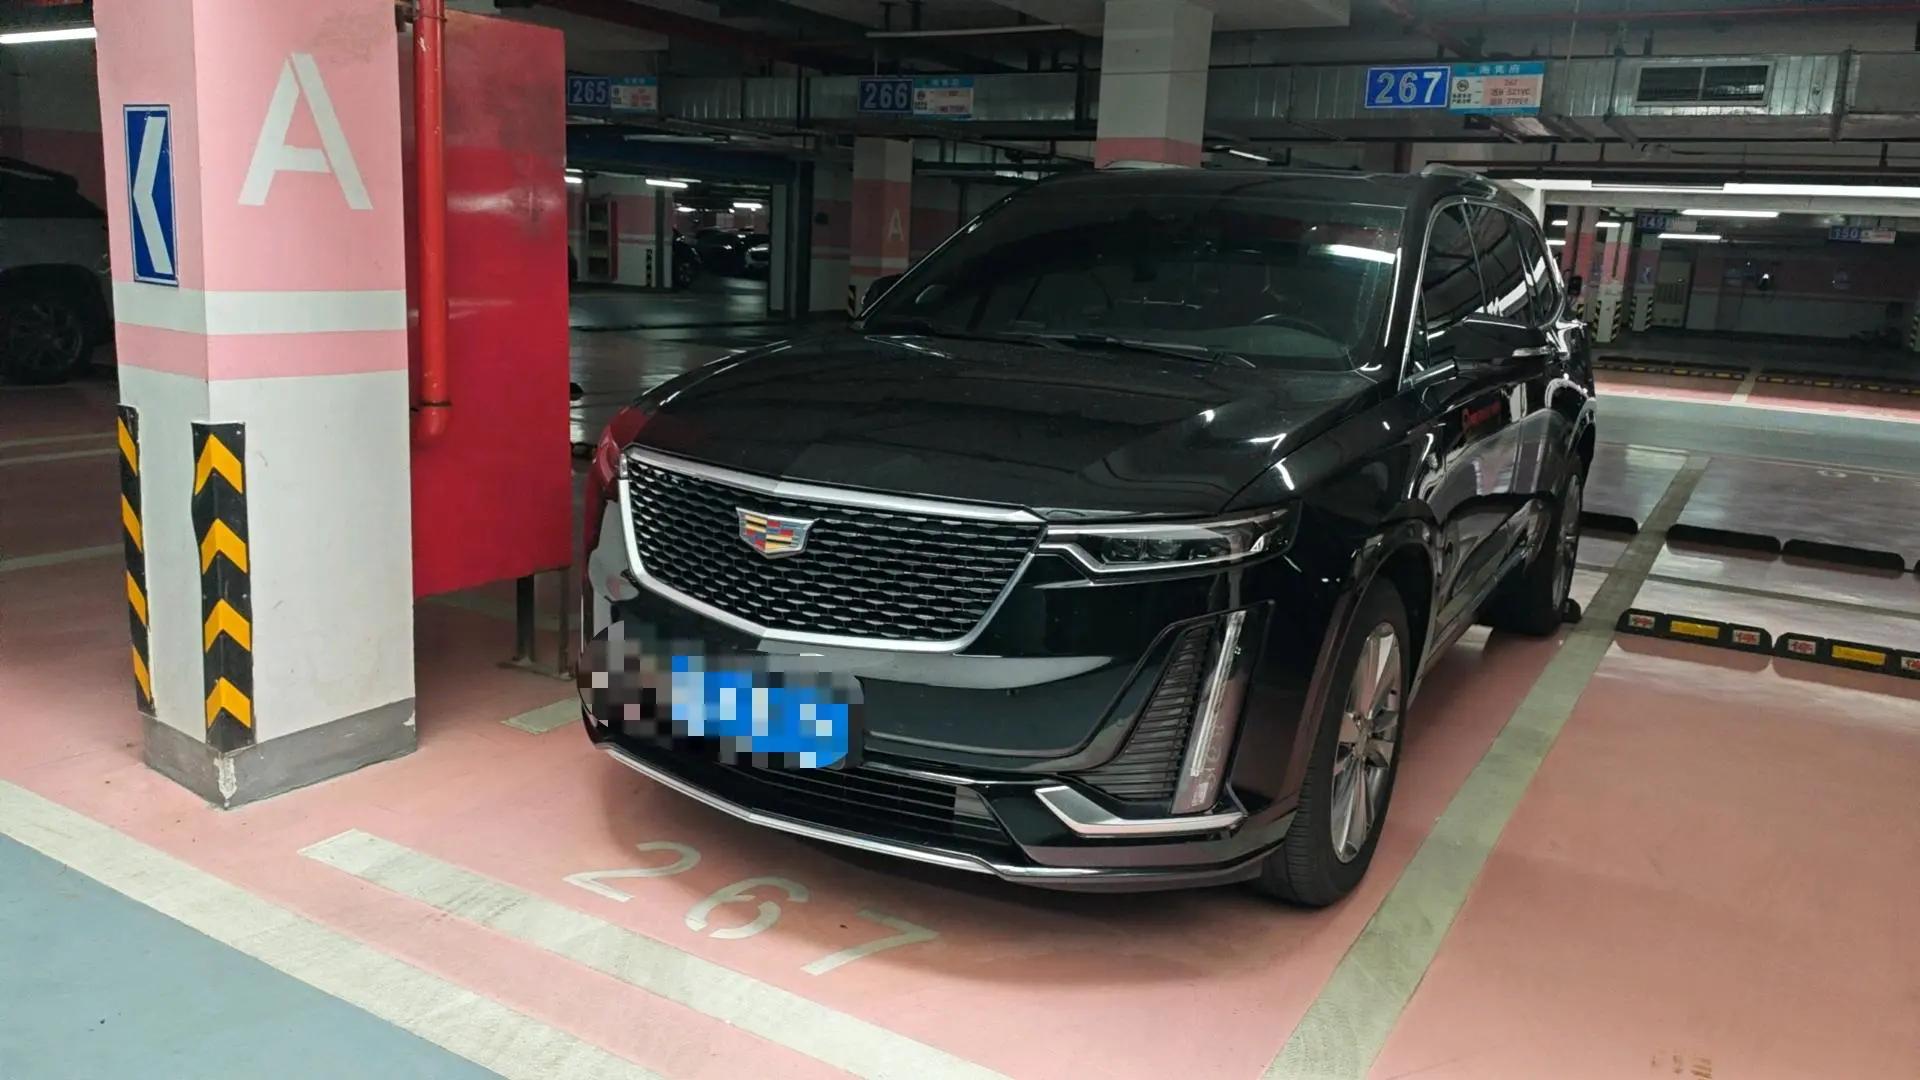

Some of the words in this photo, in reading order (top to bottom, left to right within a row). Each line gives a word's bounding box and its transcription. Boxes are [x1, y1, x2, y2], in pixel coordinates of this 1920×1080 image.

[573, 80, 607, 104] 265
[863, 82, 909, 109] 266
[1375, 71, 1444, 104] 267
[237, 52, 375, 211] A
[887, 208, 904, 241] A
[562, 840, 940, 976] 267
